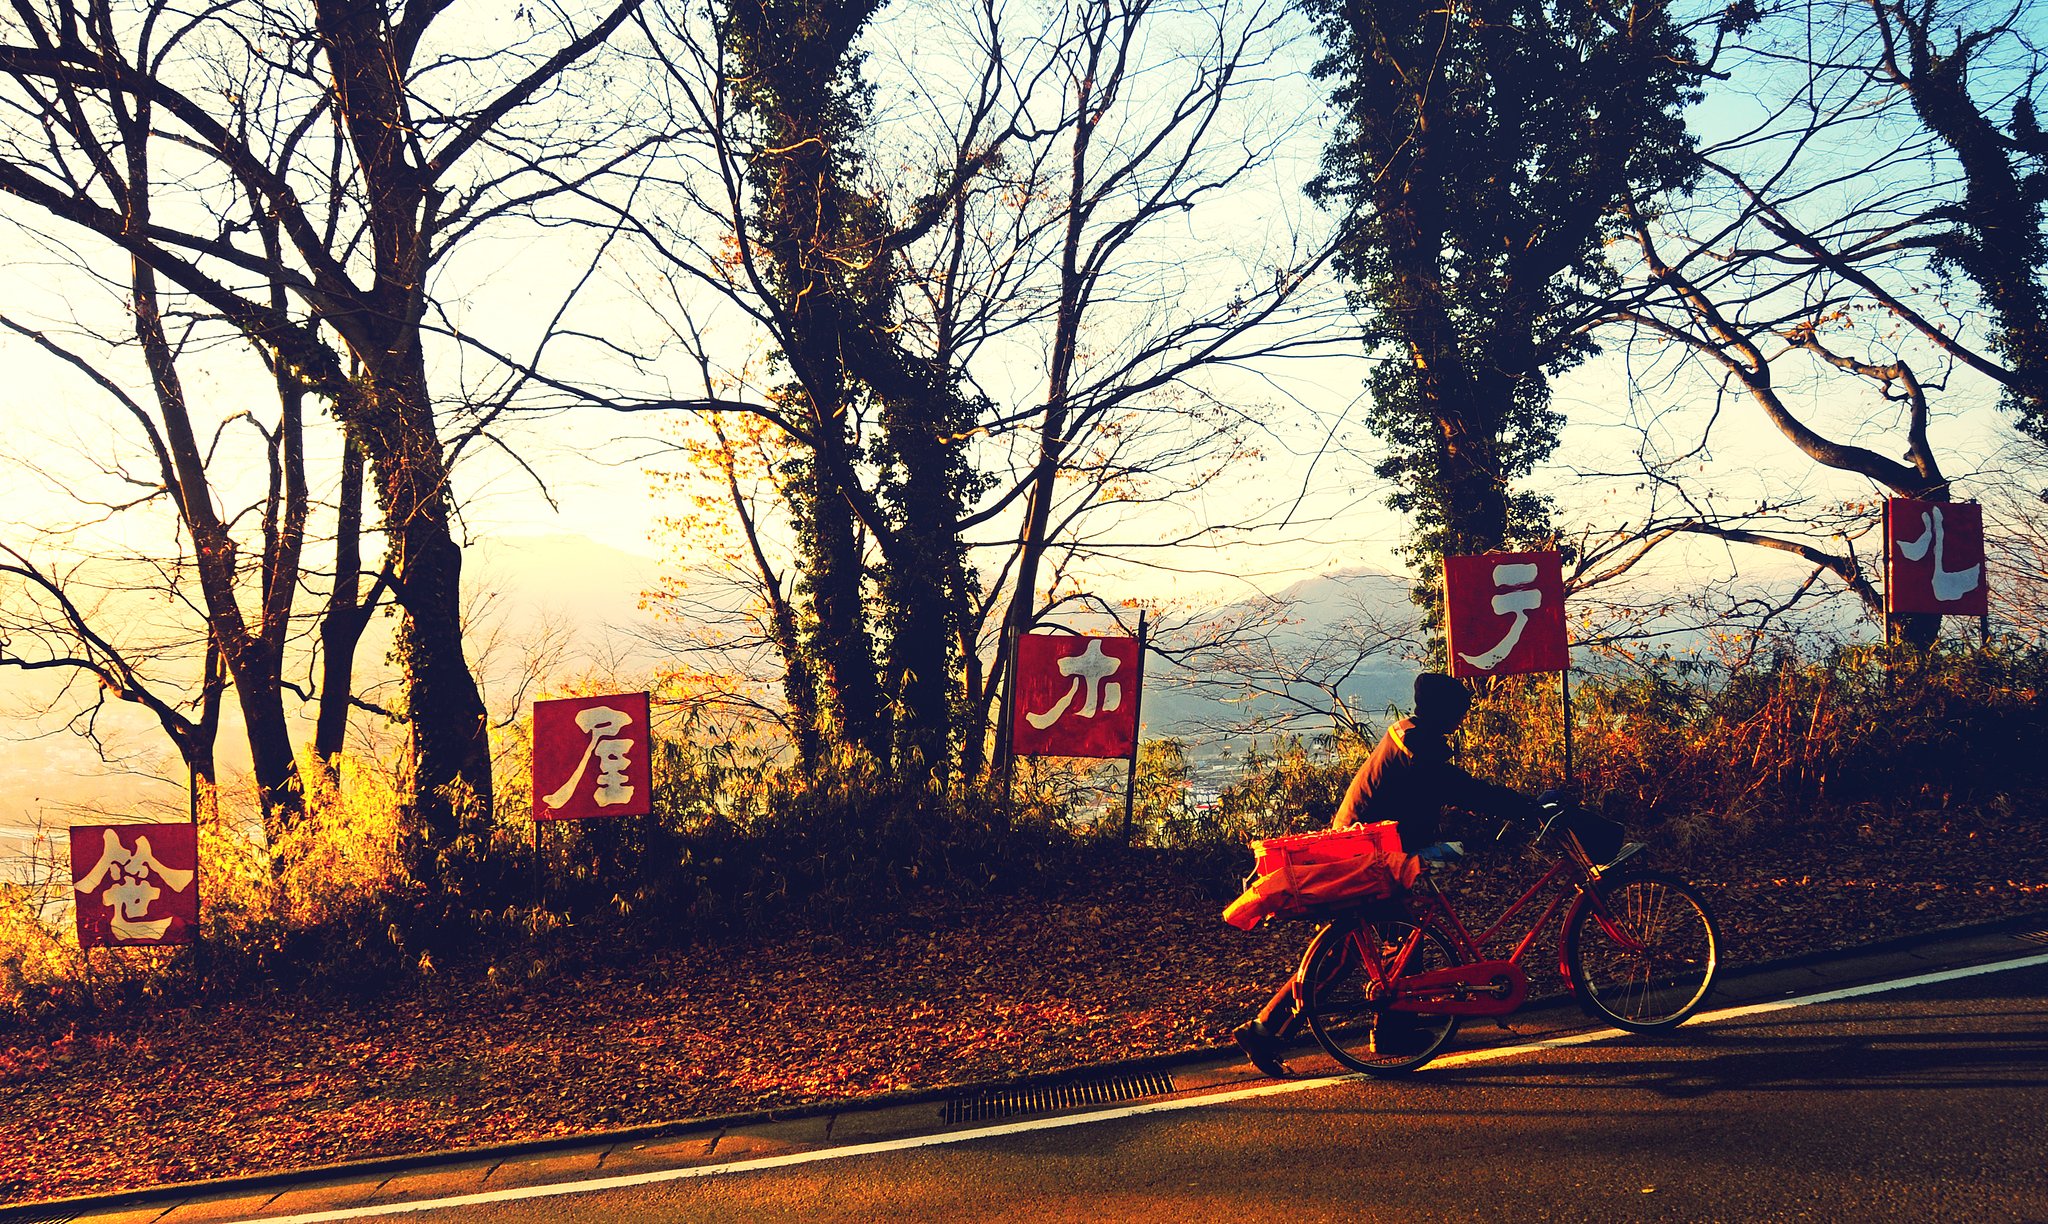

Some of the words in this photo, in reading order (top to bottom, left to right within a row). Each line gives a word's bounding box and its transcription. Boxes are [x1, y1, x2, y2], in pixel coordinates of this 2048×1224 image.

[1896, 506, 1980, 602] ル
[1458, 563, 1542, 670] テ
[1025, 639, 1122, 730] ホ
[542, 705, 635, 809] 屋
[73, 828, 194, 941] 笹
